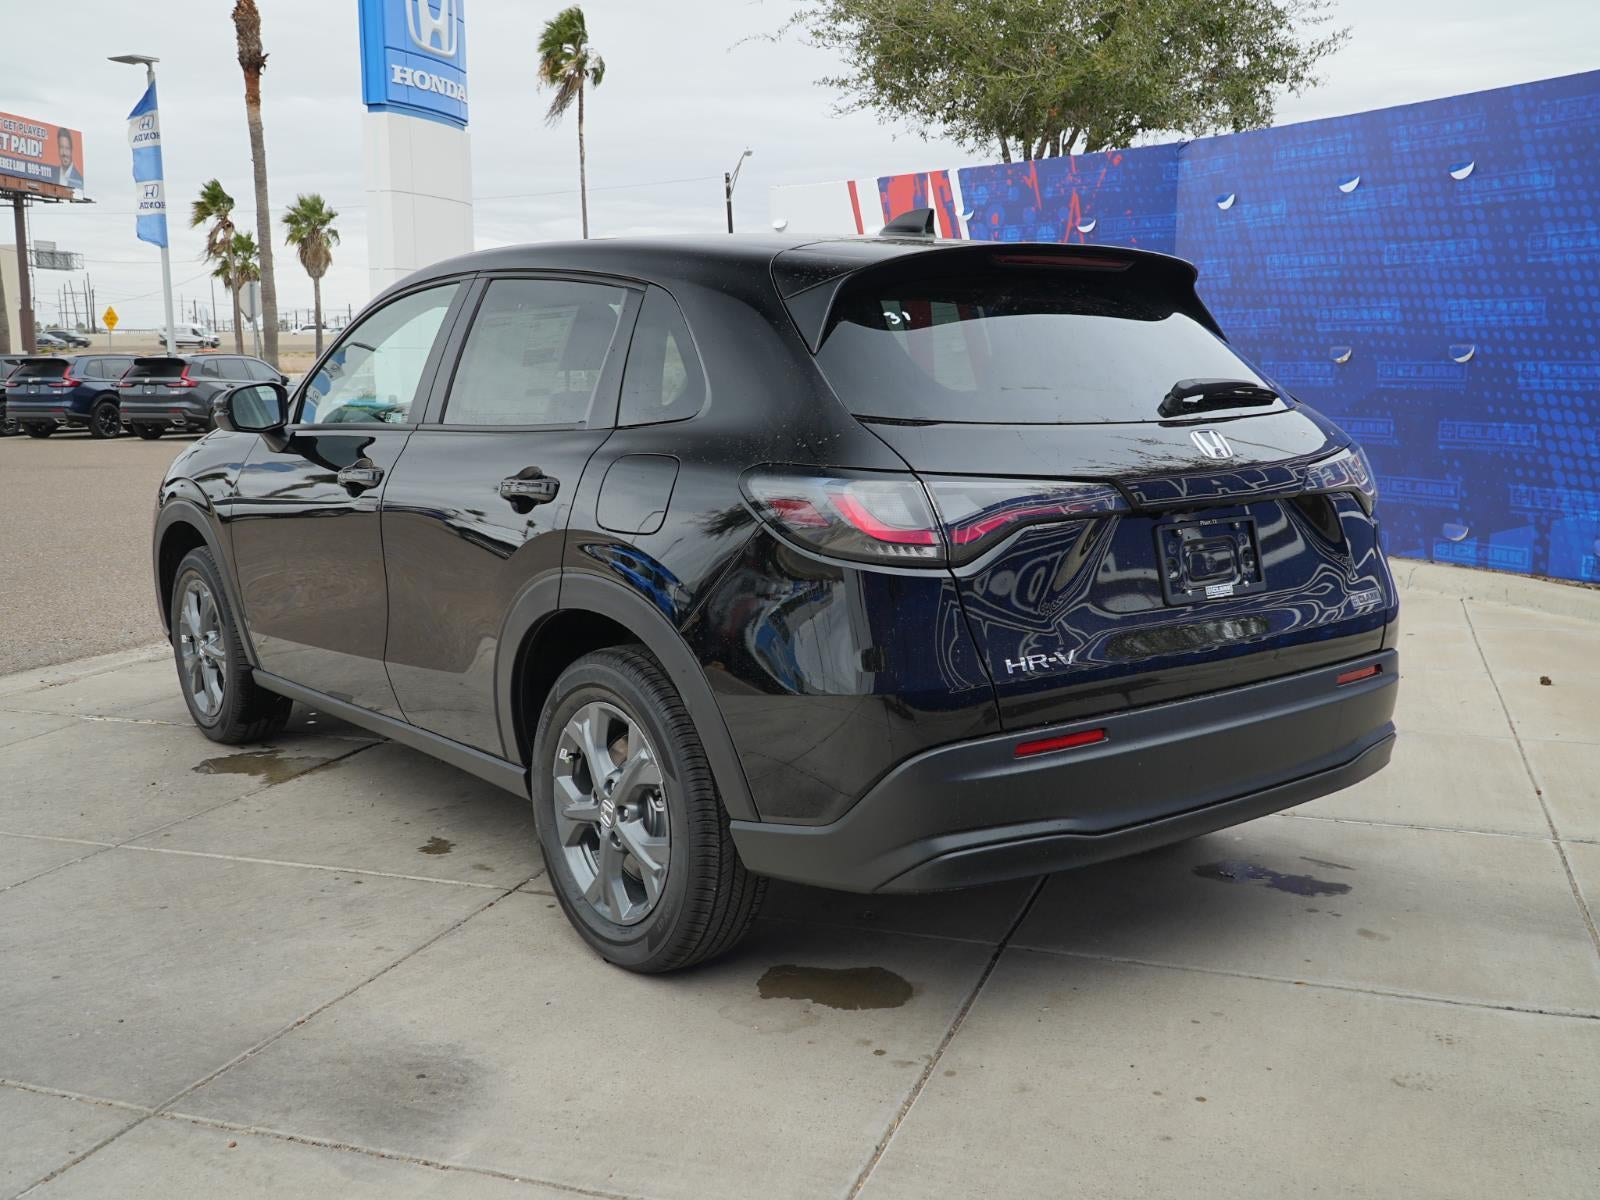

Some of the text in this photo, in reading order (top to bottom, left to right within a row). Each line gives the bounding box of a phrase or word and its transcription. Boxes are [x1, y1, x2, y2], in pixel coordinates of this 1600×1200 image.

[391, 64, 468, 104] HONDA
[3, 119, 17, 132] GET
[10, 134, 43, 158] PAID!
[1005, 649, 1075, 675] HR-V
